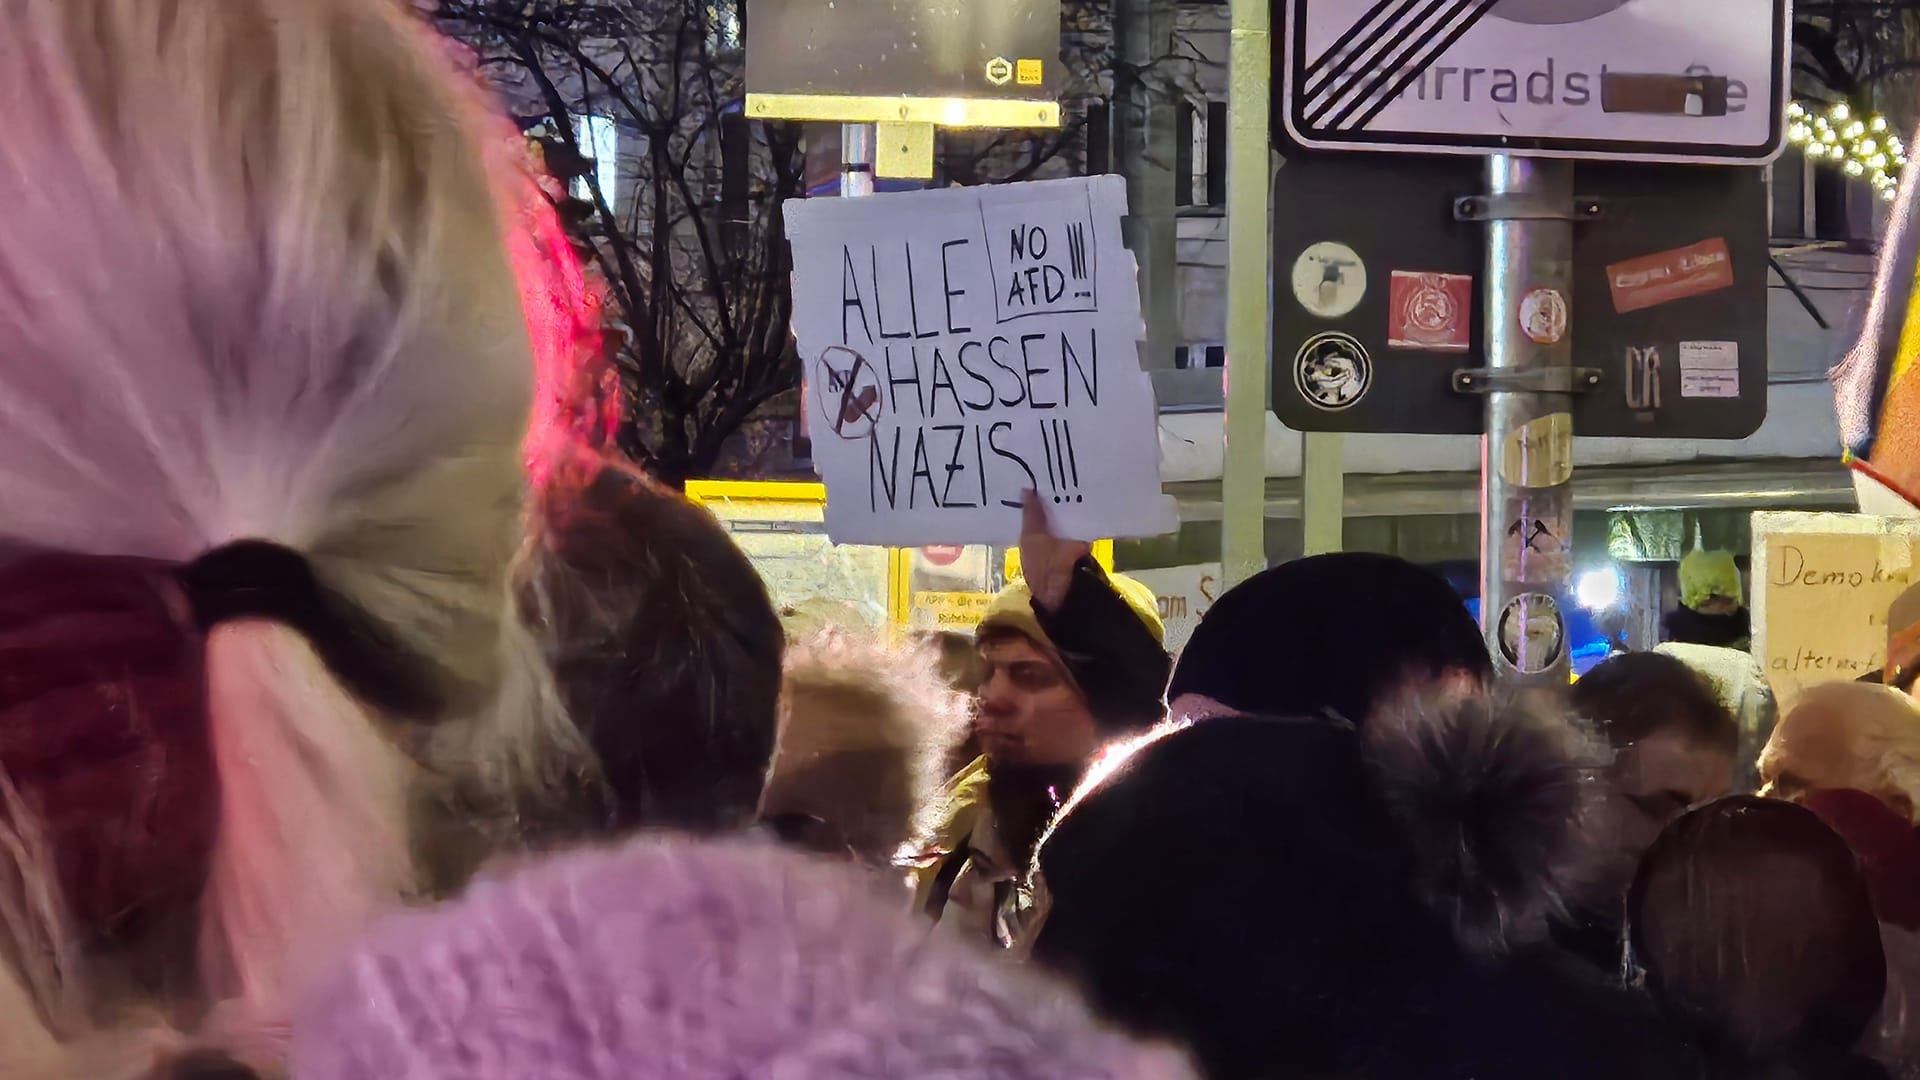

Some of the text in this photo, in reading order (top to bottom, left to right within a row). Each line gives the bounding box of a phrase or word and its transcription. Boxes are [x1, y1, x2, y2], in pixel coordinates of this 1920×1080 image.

[1010, 223, 1047, 264] NO
[842, 239, 971, 345] ALLE
[884, 328, 1098, 419] HASSEN
